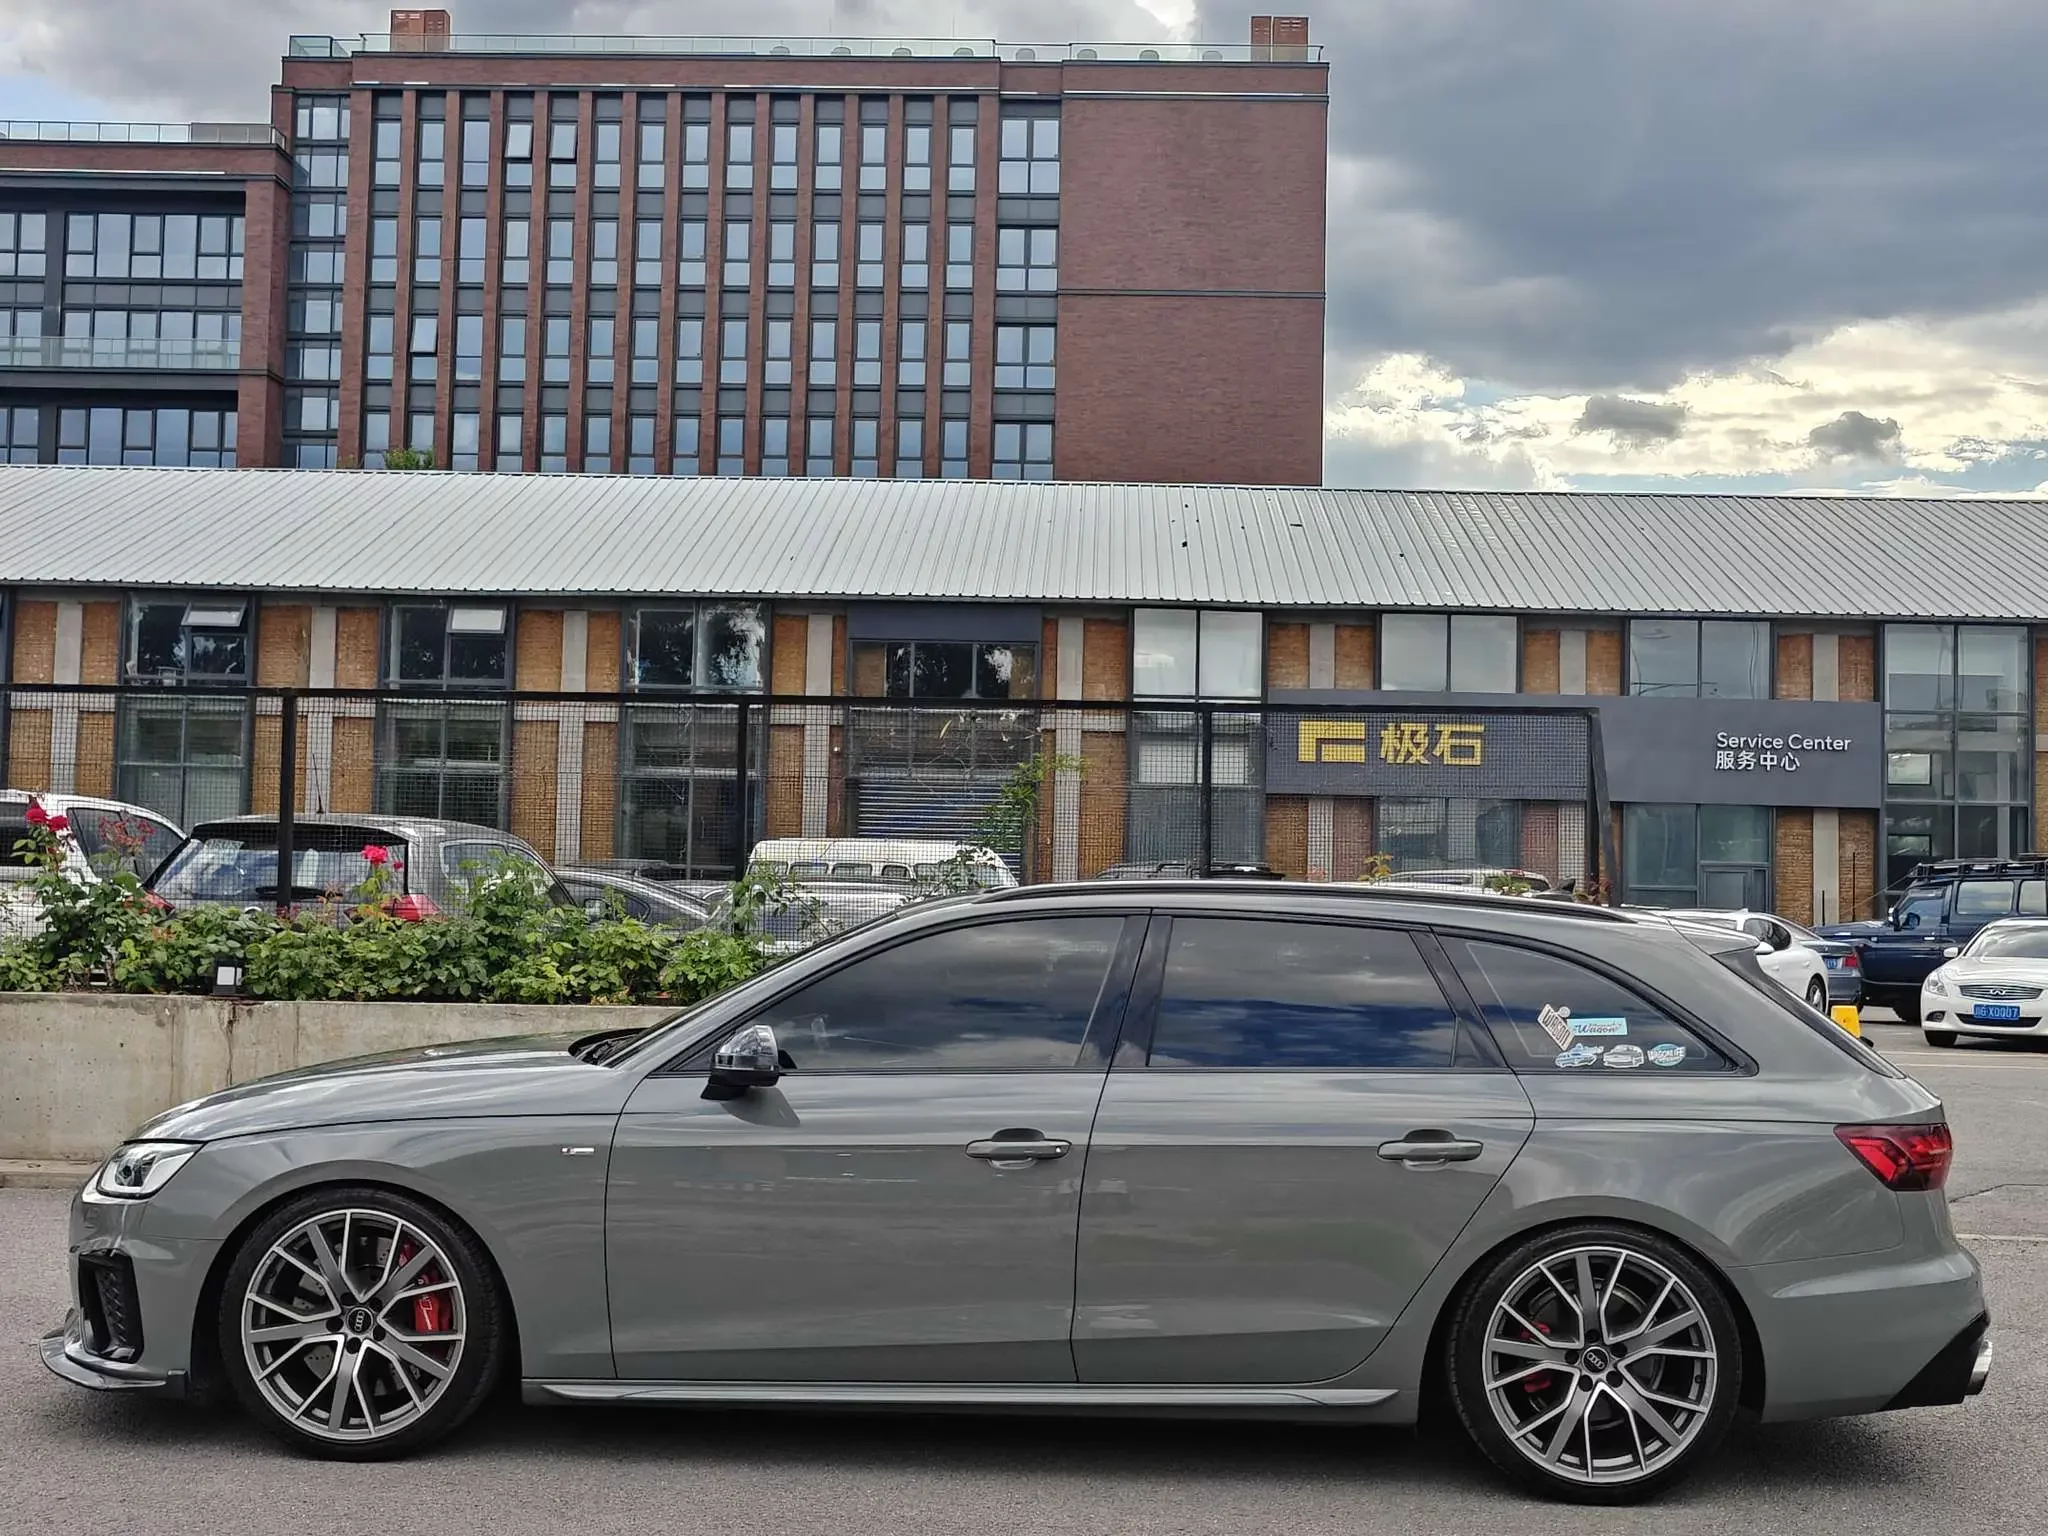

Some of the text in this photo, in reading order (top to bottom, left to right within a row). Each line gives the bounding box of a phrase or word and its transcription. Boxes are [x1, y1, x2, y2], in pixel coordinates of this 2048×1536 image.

[1379, 722, 1485, 766] 极石
[1716, 731, 1852, 750] Service Center
[1715, 750, 1801, 771] 服务中心
